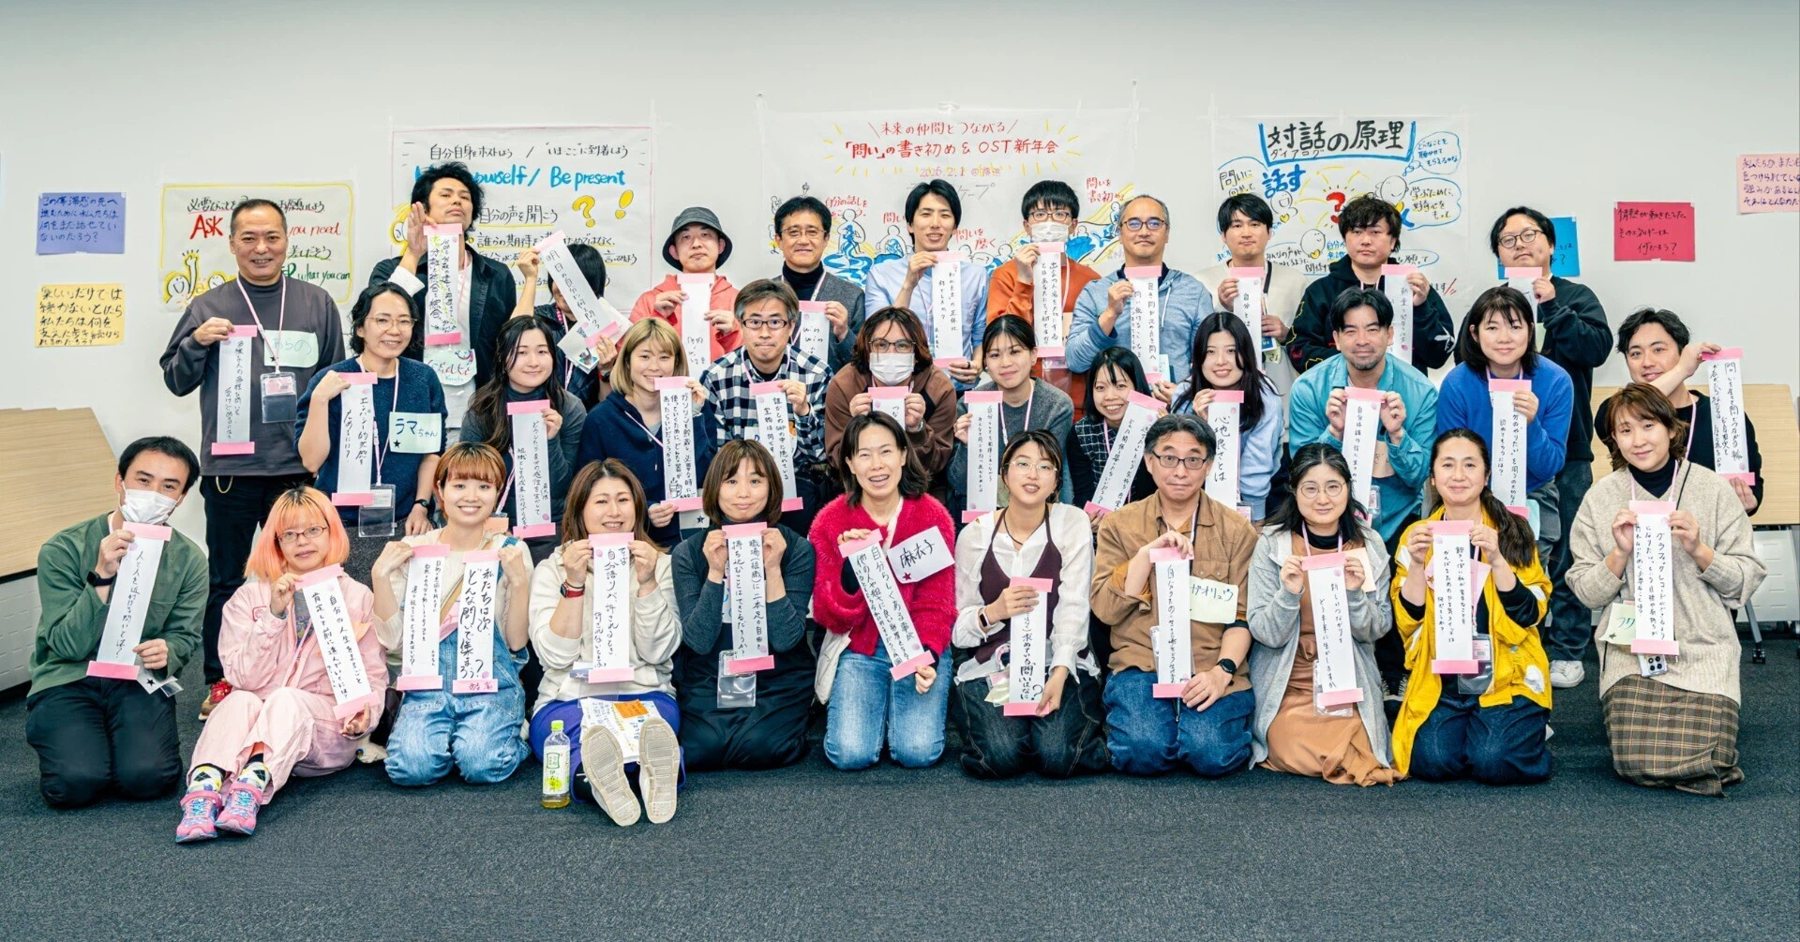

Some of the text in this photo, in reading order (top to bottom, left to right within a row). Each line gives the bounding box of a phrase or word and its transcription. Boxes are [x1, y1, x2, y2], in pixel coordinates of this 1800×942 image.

[1267, 119, 1405, 151] 対話の原理
[550, 165, 571, 187] Be
[574, 166, 625, 191] present
[1262, 163, 1307, 199] 話す
[189, 214, 224, 241] ASK
[310, 221, 342, 236] need
[395, 417, 439, 438] ラマちゃん
